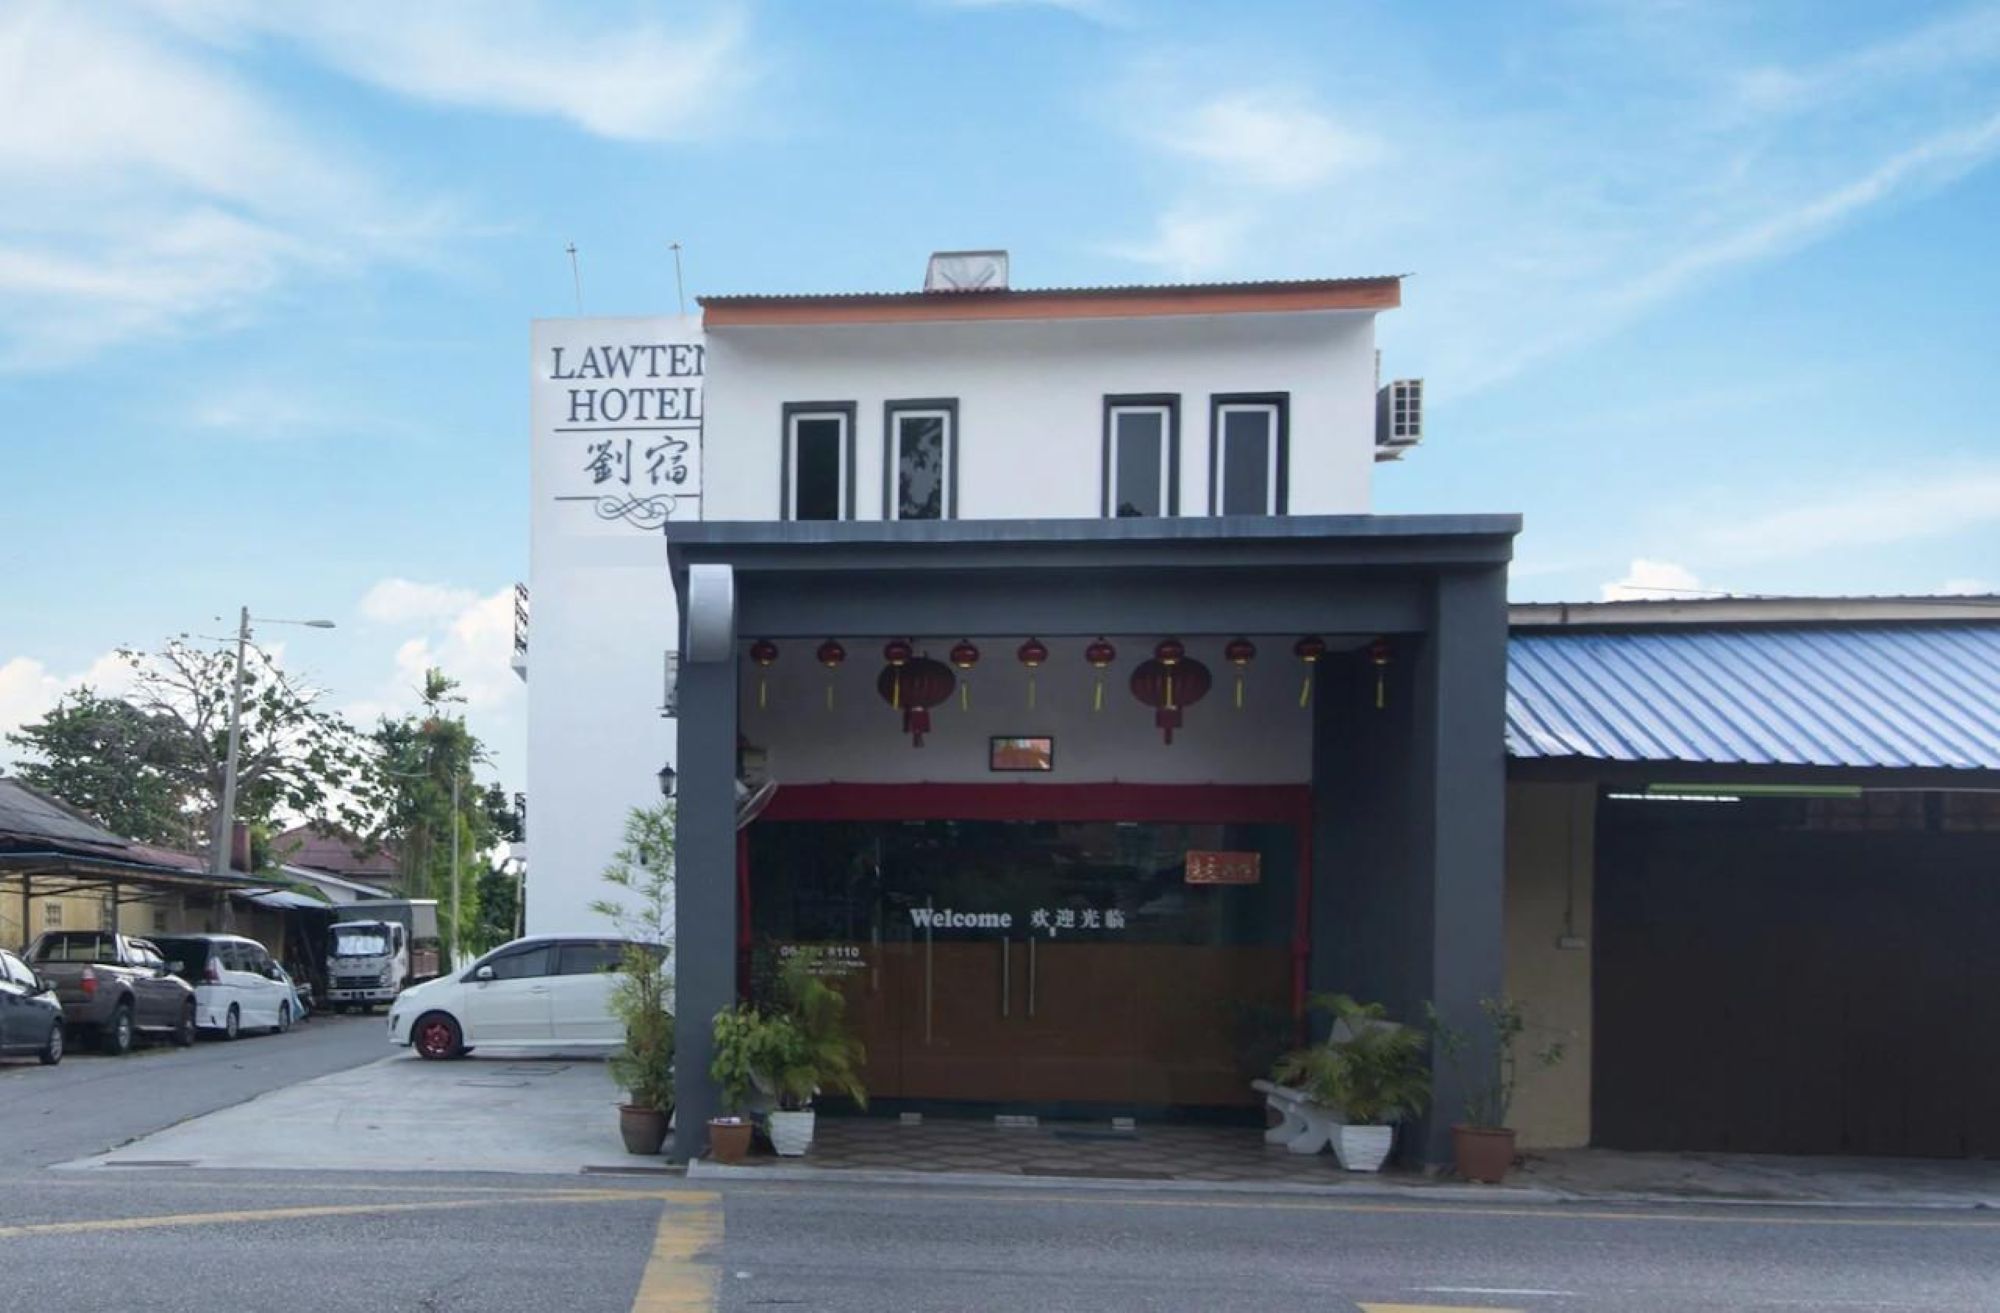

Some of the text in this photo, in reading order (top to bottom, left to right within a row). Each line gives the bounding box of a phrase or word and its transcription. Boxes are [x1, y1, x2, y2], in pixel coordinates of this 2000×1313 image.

[567, 387, 701, 422] HOTEL
[910, 908, 1125, 928] Welcome 欢迎光临
